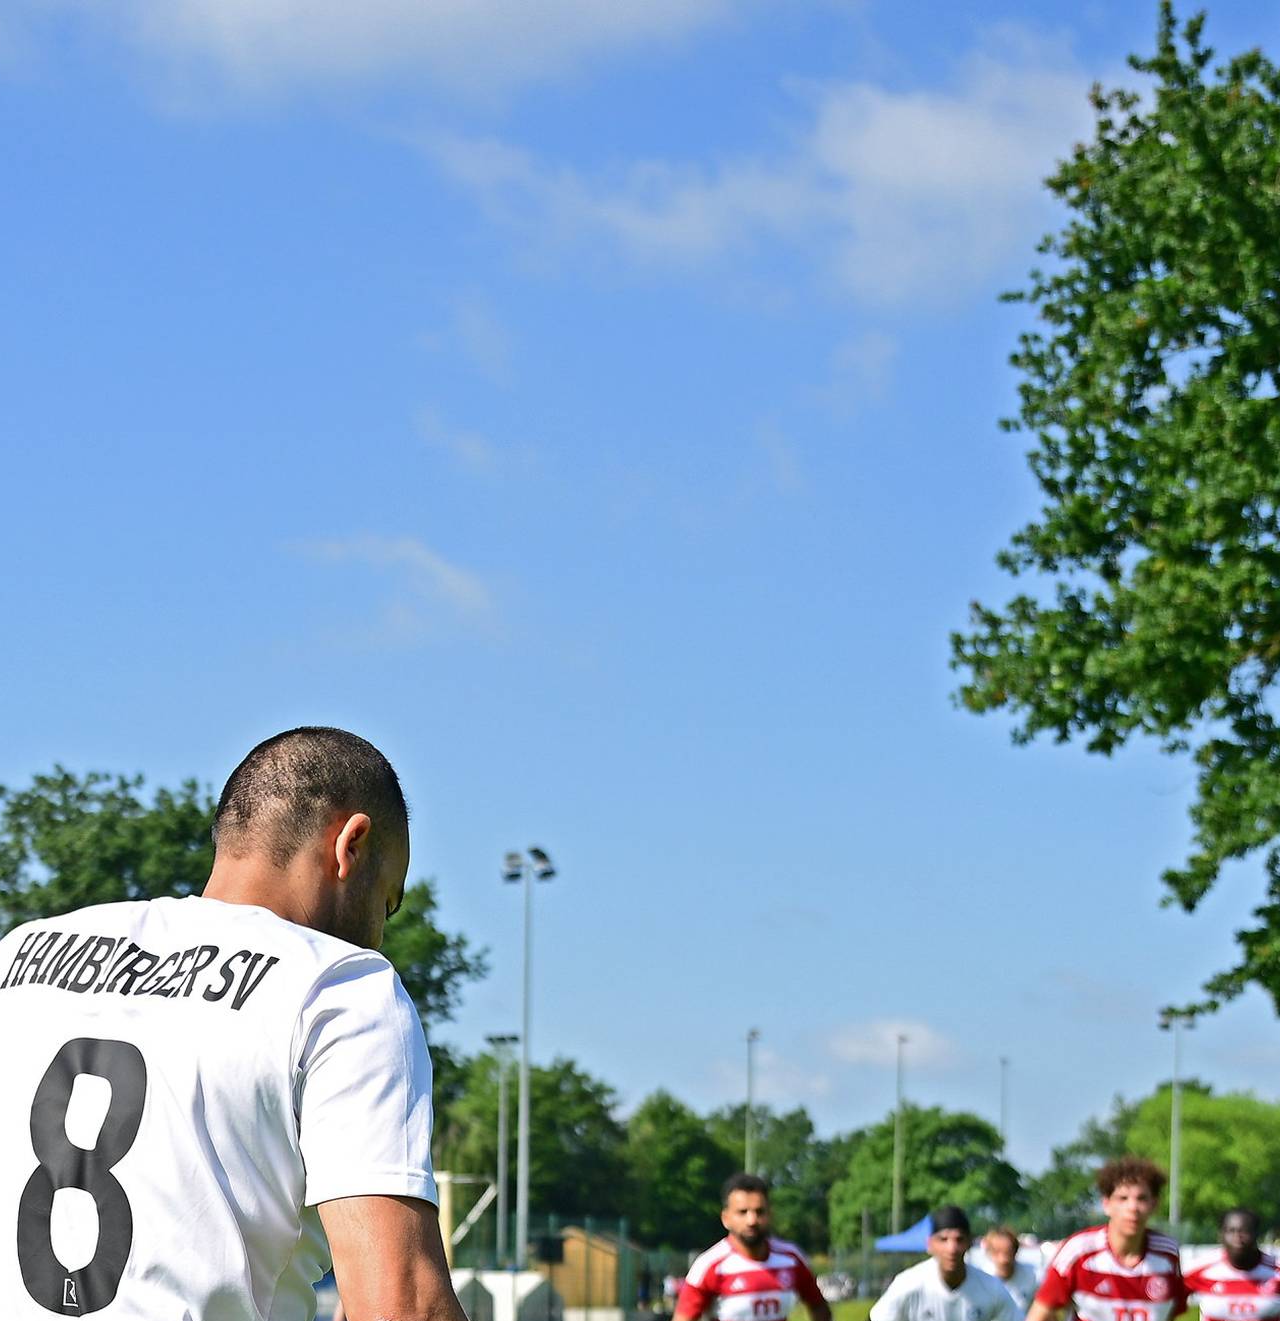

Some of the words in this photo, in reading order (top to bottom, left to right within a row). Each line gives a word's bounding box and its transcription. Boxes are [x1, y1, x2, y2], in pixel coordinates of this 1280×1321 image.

[0, 930, 220, 997] HAMBURGER
[201, 949, 281, 1012] SV
[16, 1036, 148, 1318] 8
